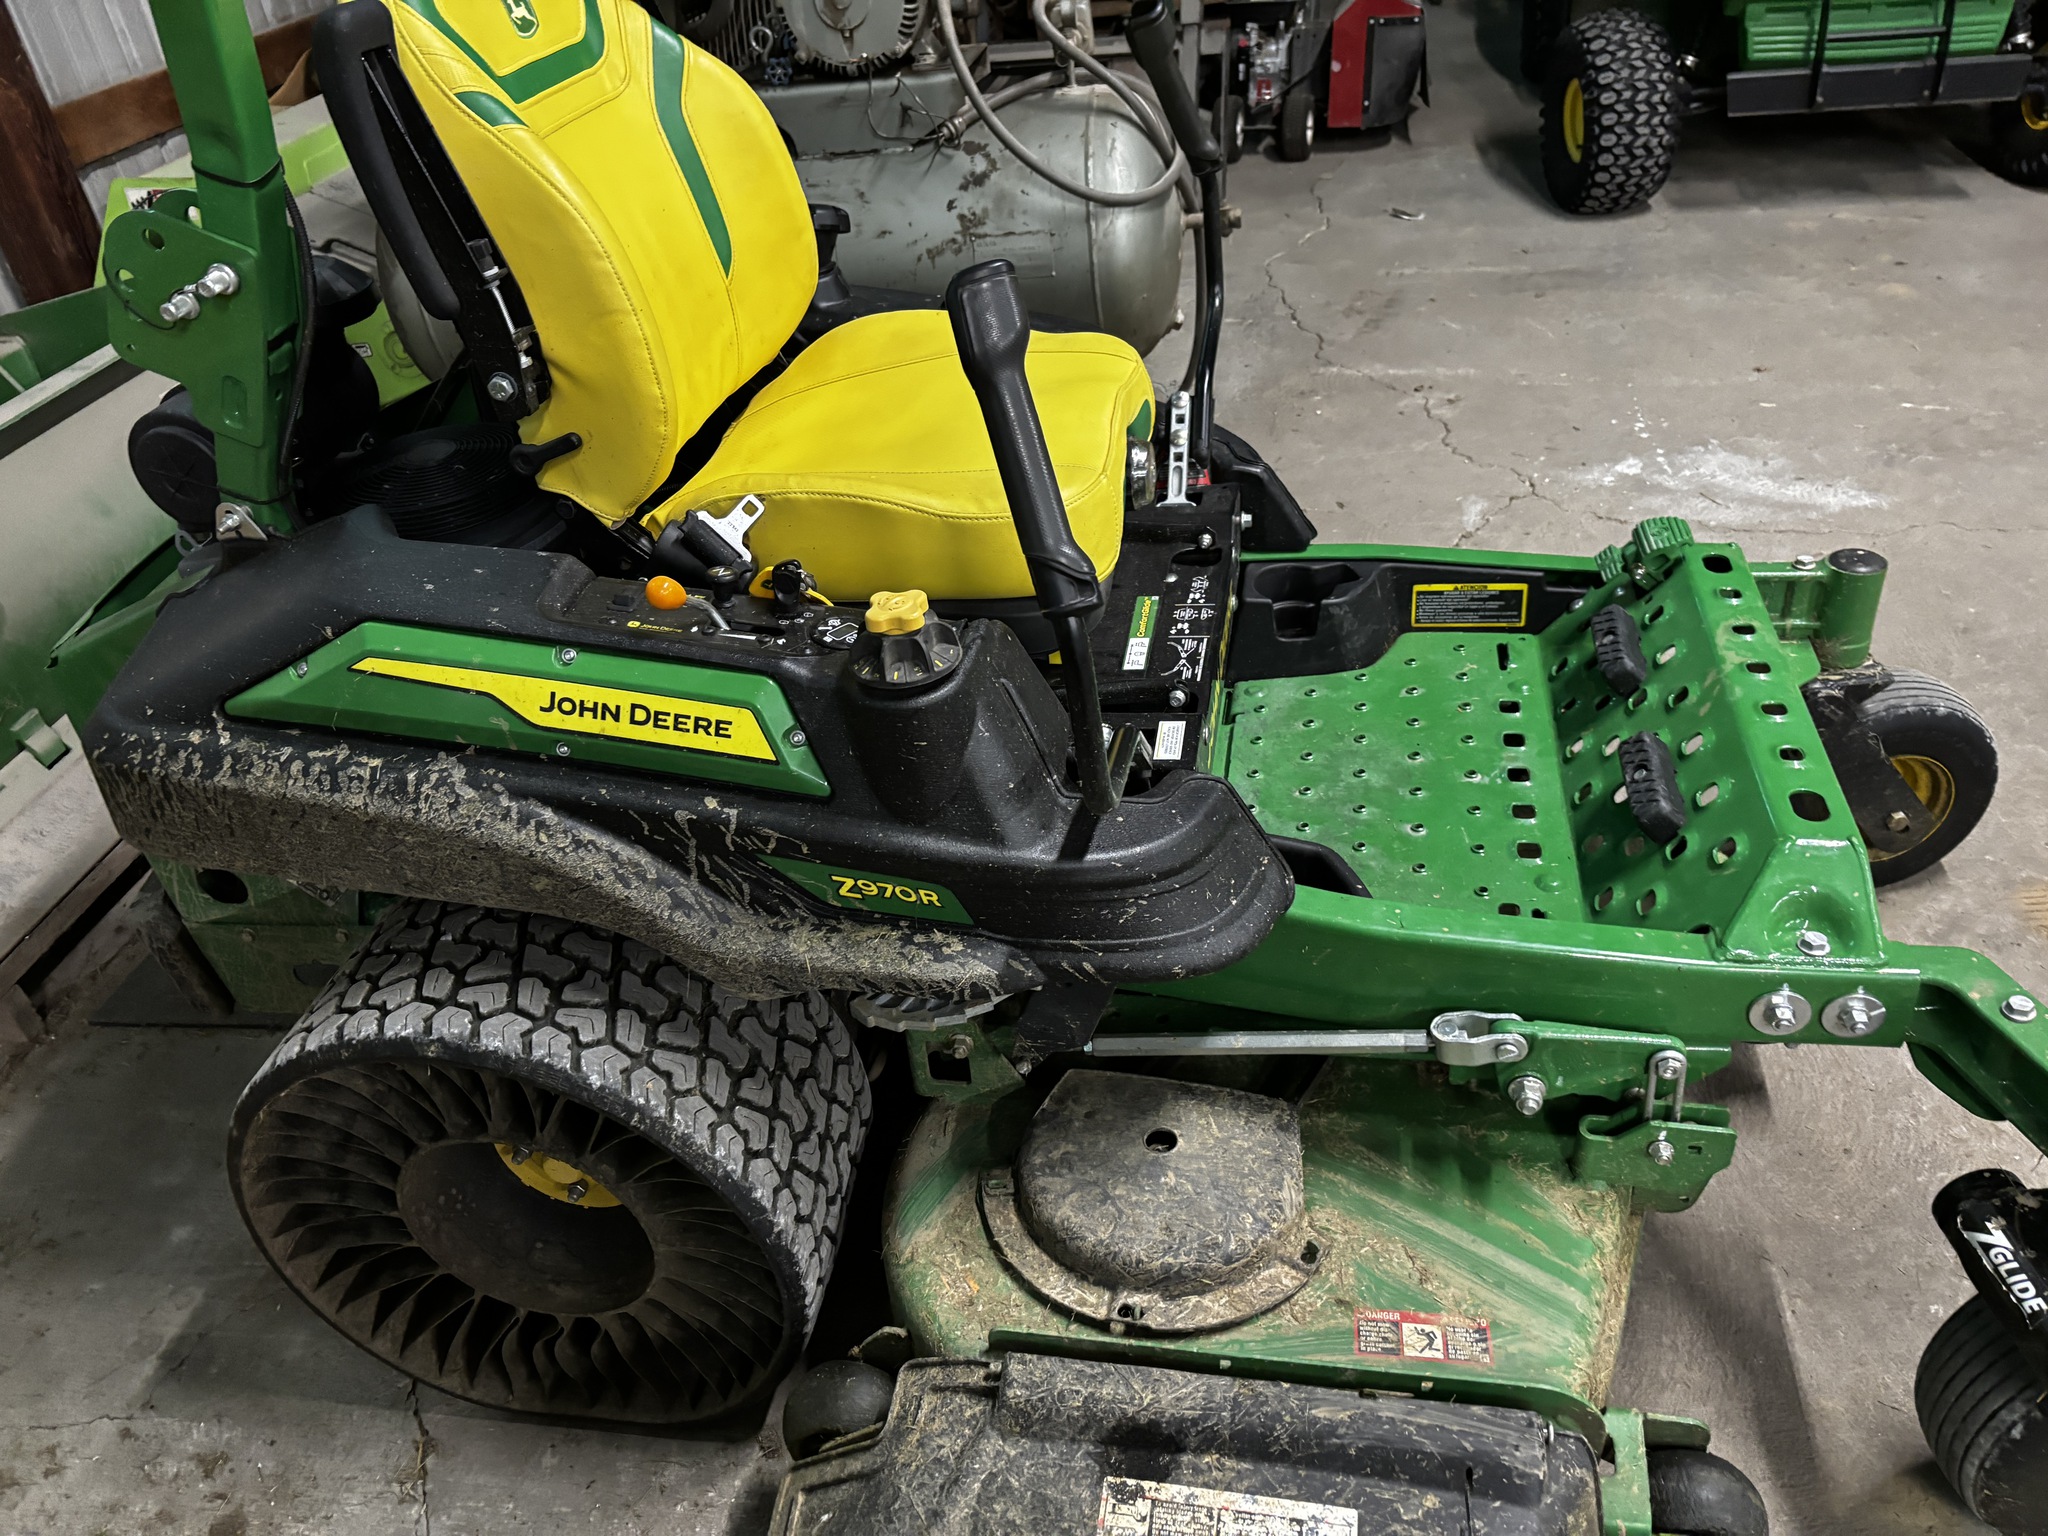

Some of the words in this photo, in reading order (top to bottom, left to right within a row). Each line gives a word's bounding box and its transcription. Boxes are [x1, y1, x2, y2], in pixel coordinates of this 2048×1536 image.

[539, 691, 621, 723] JOHN
[629, 703, 733, 739] DEERE
[831, 875, 943, 907] Z970R
[1365, 1310, 1401, 1321] DANGER
